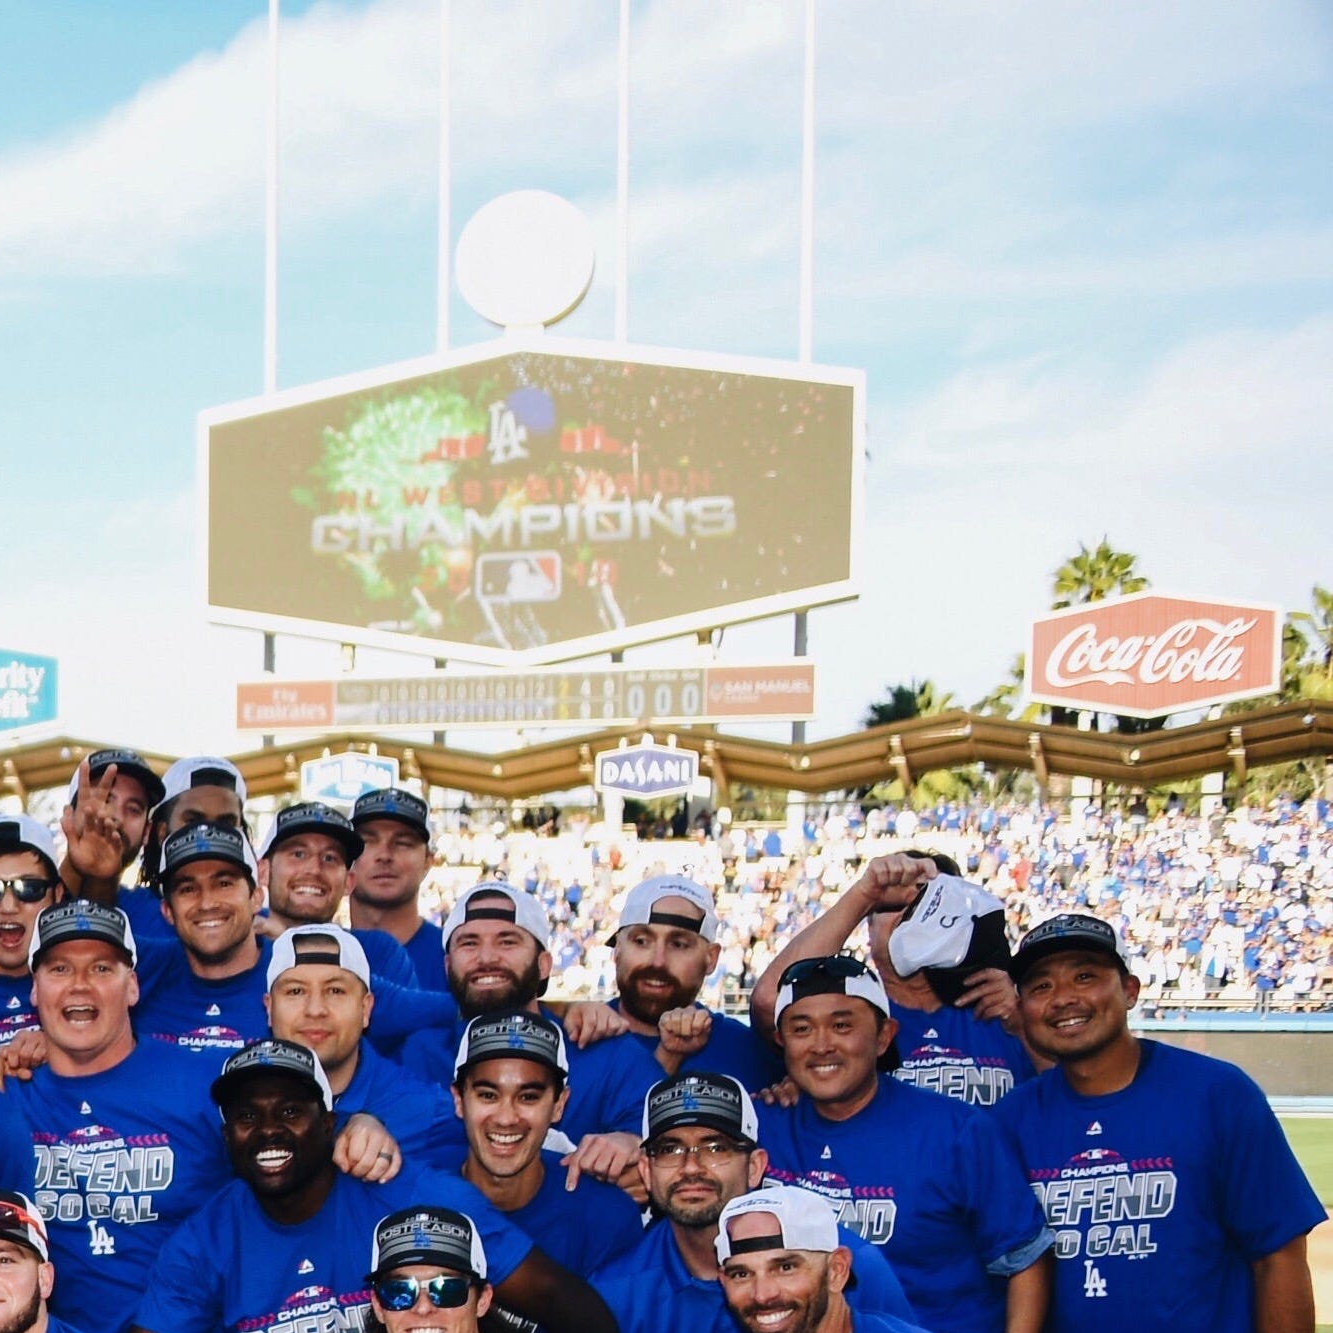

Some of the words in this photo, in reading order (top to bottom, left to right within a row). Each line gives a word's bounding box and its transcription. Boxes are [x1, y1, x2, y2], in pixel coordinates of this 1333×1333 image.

[311, 496, 737, 554] CHAMPIONS
[1045, 617, 1259, 688] Coca-Cola
[724, 681, 753, 694] SAN
[755, 678, 811, 694] MANUEL
[243, 702, 327, 722] Emirates
[601, 758, 691, 785] DASANI
[902, 1056, 977, 1068] CHAMPIONS
[892, 1066, 1015, 1106] EFEND
[33, 1144, 174, 1192] DEFEND
[1061, 1162, 1130, 1178] CHAMPIONS
[34, 1192, 84, 1222] SO
[85, 1192, 159, 1224] CAL
[87, 1220, 116, 1256] LA
[1085, 1223, 1158, 1256] CAL
[1083, 1259, 1107, 1298] LA
